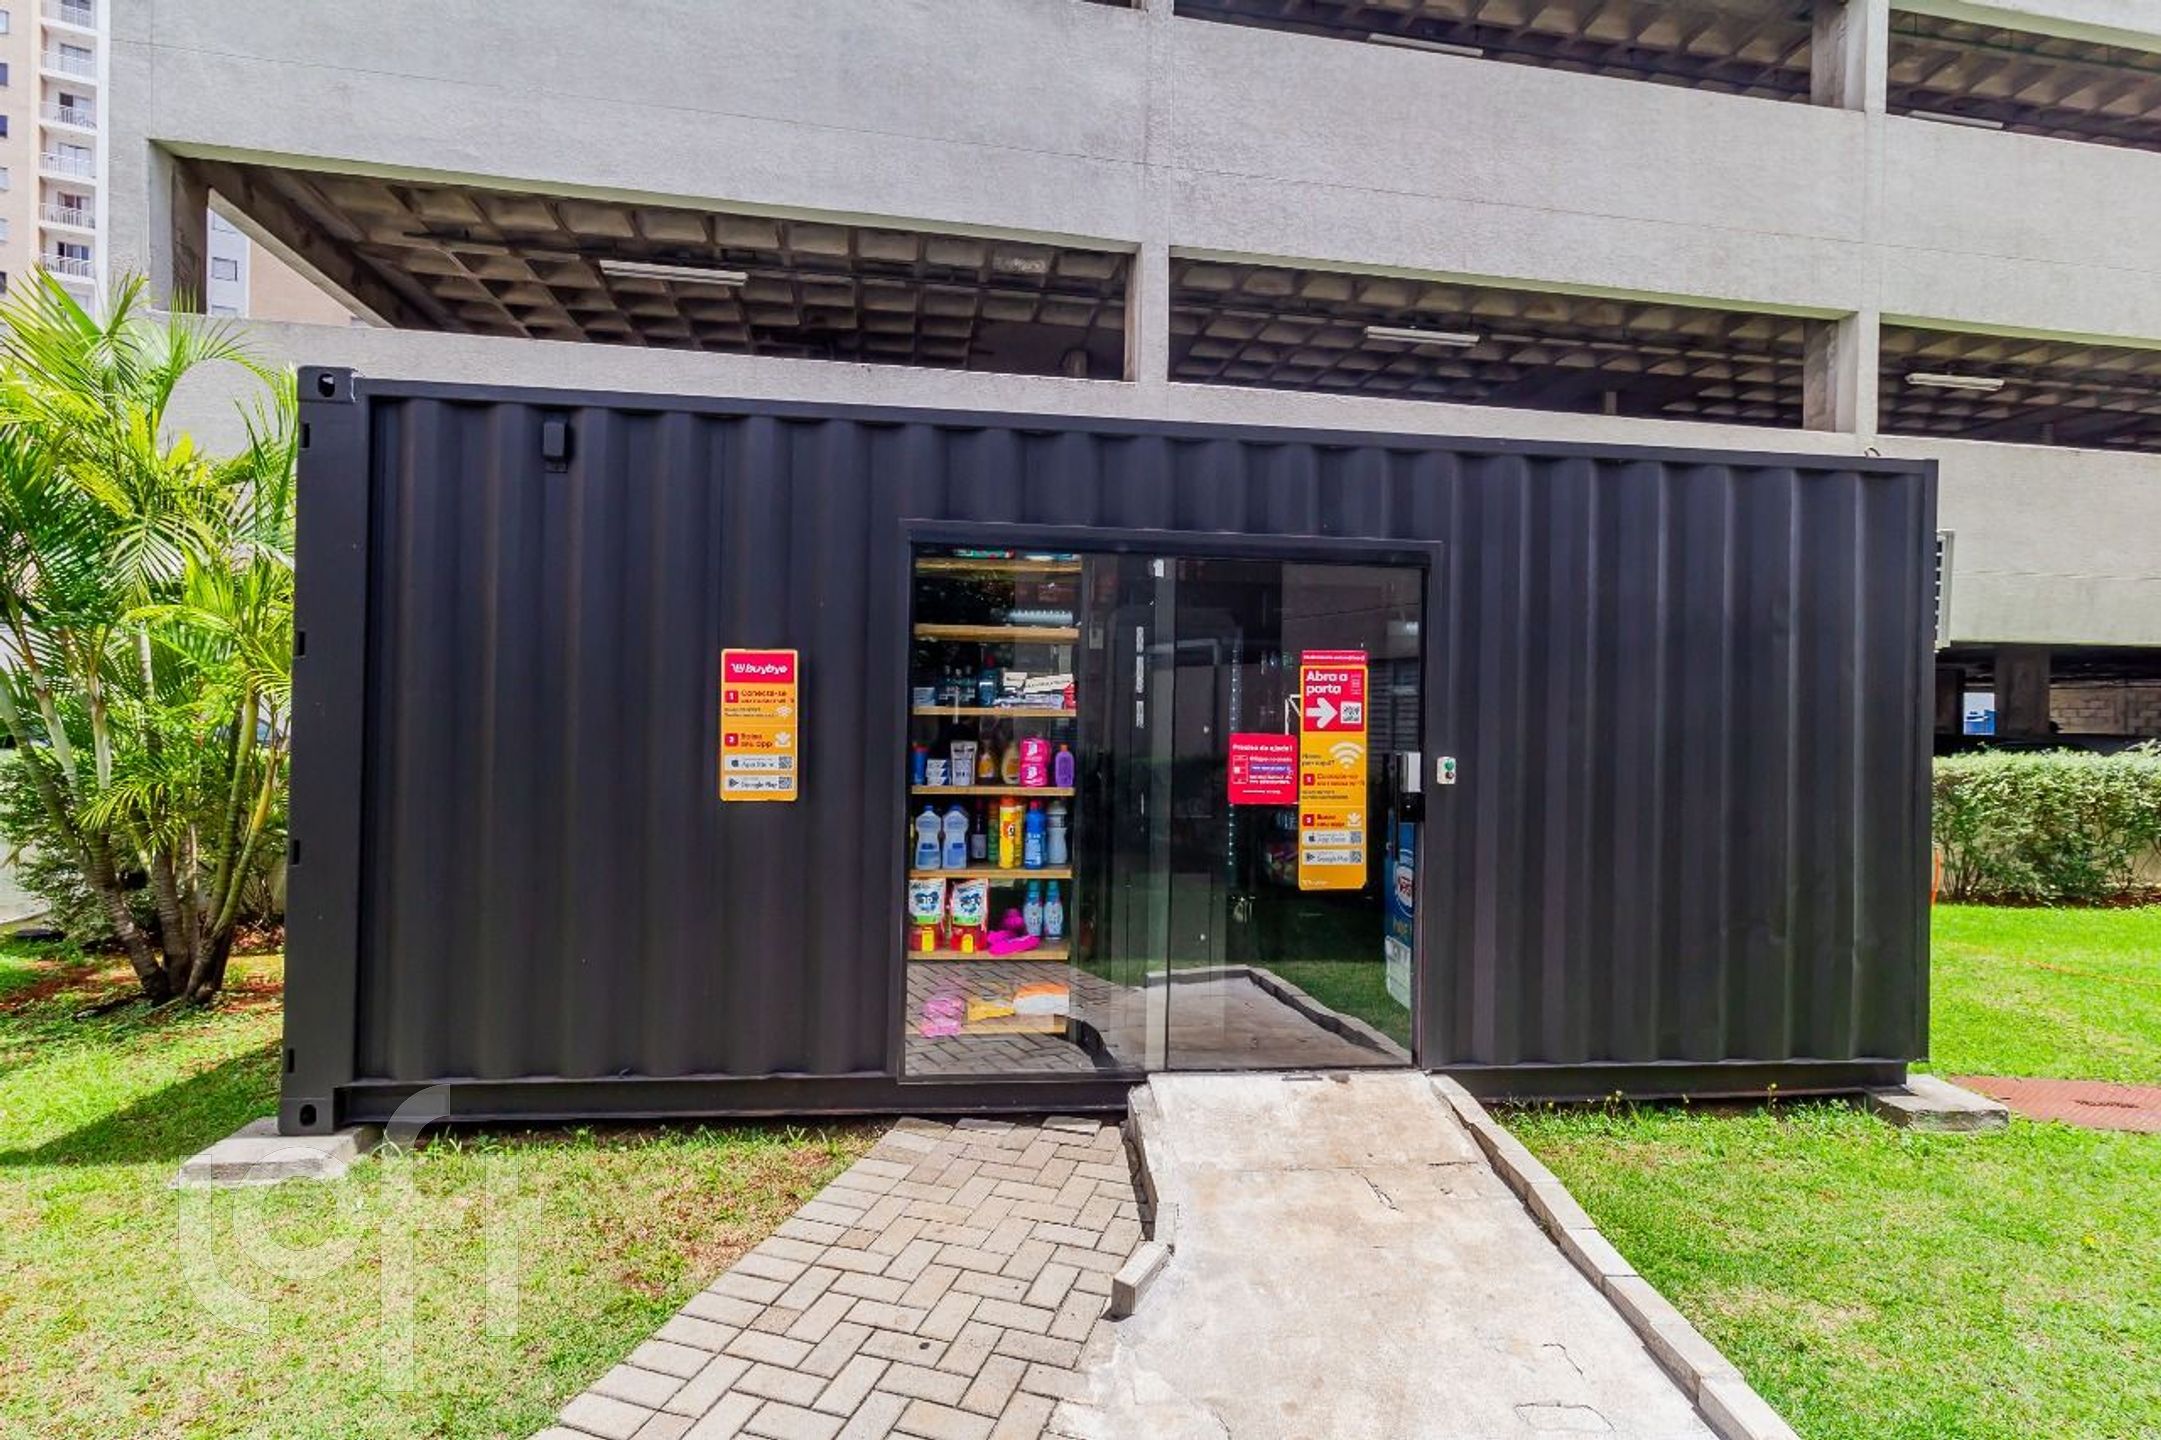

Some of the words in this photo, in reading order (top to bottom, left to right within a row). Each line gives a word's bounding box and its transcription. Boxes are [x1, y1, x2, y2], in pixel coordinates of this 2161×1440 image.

[1305, 669, 1338, 682] Abra
[1339, 672, 1348, 682] a
[1305, 684, 1342, 697] porta
[756, 741, 773, 749] app
